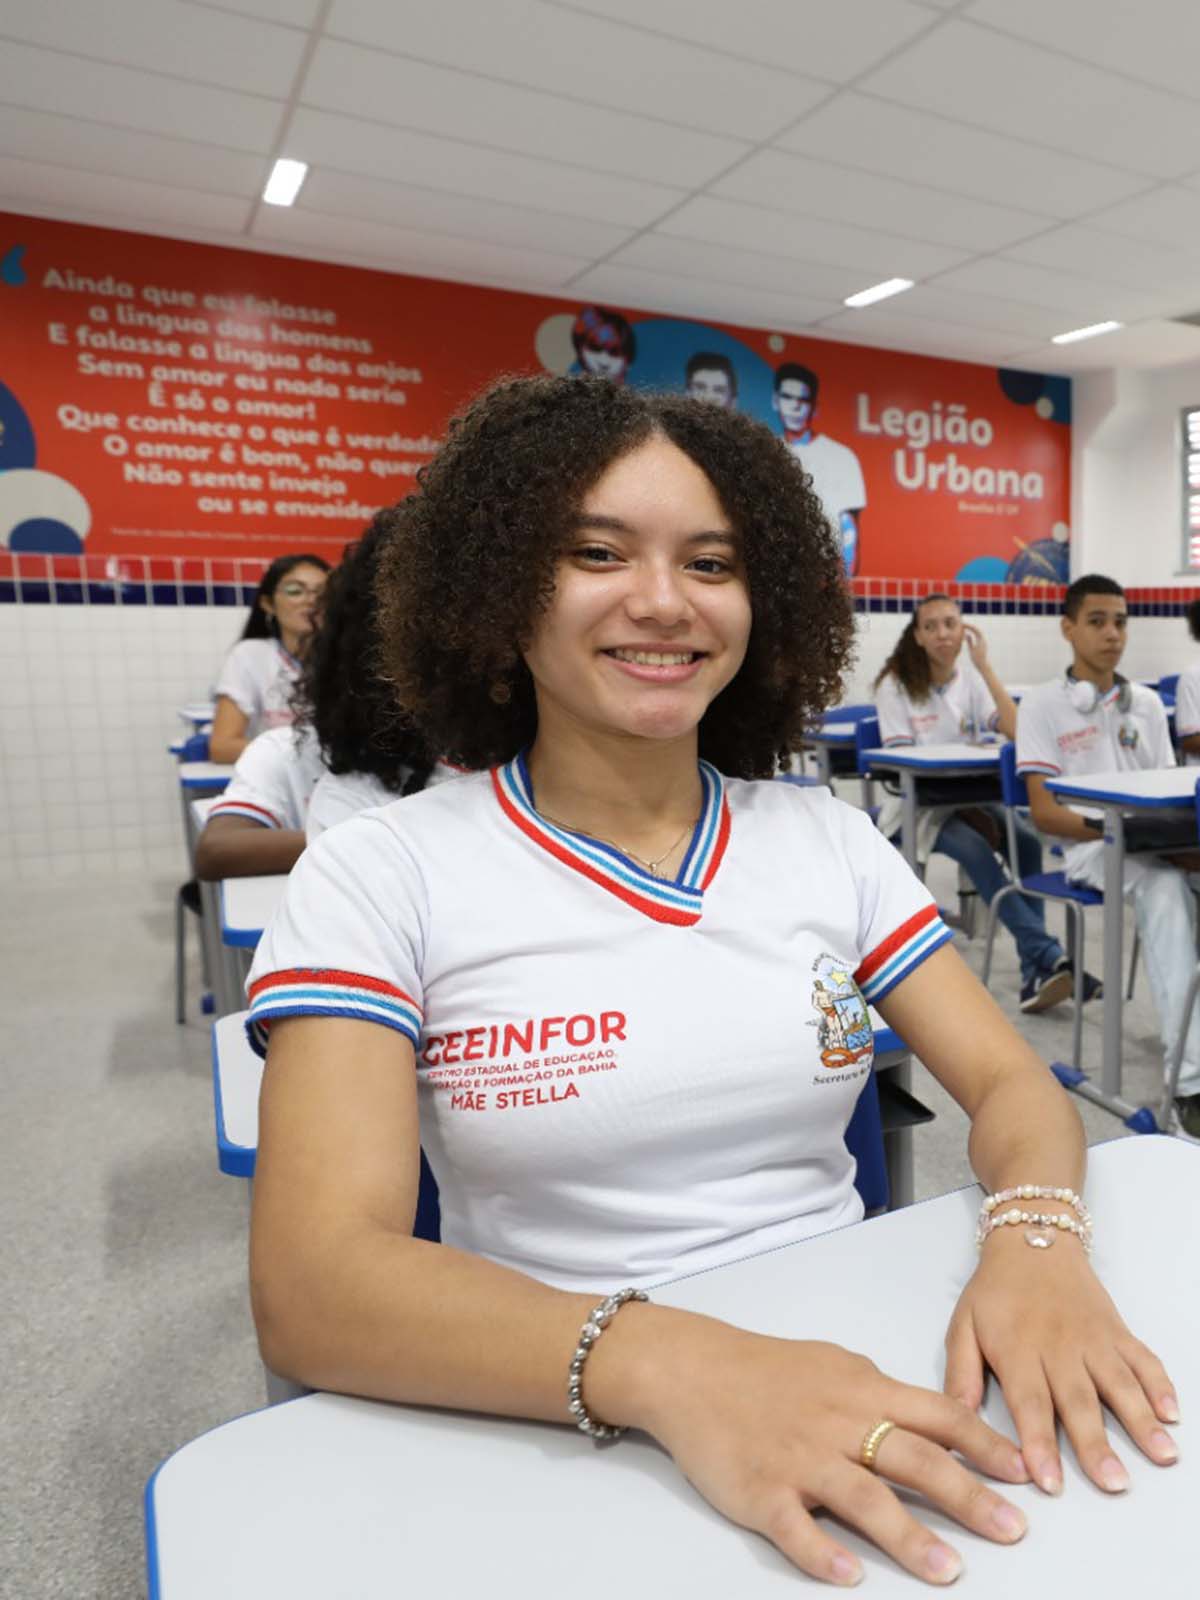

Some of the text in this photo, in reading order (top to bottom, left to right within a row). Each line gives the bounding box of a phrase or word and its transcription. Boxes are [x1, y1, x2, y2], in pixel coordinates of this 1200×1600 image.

[43, 268, 134, 298] Ainda
[142, 286, 194, 307] que
[48, 322, 68, 345] E
[76, 324, 182, 358] falasse
[357, 361, 423, 384] anjos
[270, 324, 373, 355] homens
[77, 352, 144, 380] Sem
[152, 365, 226, 387] amor
[234, 371, 268, 392] eu
[274, 377, 340, 399] nada
[56, 403, 119, 433] Que
[126, 414, 242, 439] conhece
[271, 427, 319, 447] que
[857, 393, 993, 448] Legião
[103, 434, 128, 456] O
[135, 442, 213, 462] amor
[315, 451, 364, 473] não
[123, 462, 348, 498] Não sente inveja
[894, 450, 1044, 499] Urbana
[197, 496, 234, 514] ou
[239, 499, 268, 515] se
[421, 1010, 627, 1066] CEEINFOR
[464, 1062, 520, 1077] ESTADUAL
[523, 1059, 540, 1070] DE
[484, 1070, 553, 1088] FORMAÇÃO
[556, 1067, 574, 1078] DA
[578, 1061, 617, 1075] BAHIA
[451, 1081, 580, 1111] MÃE STELLA
